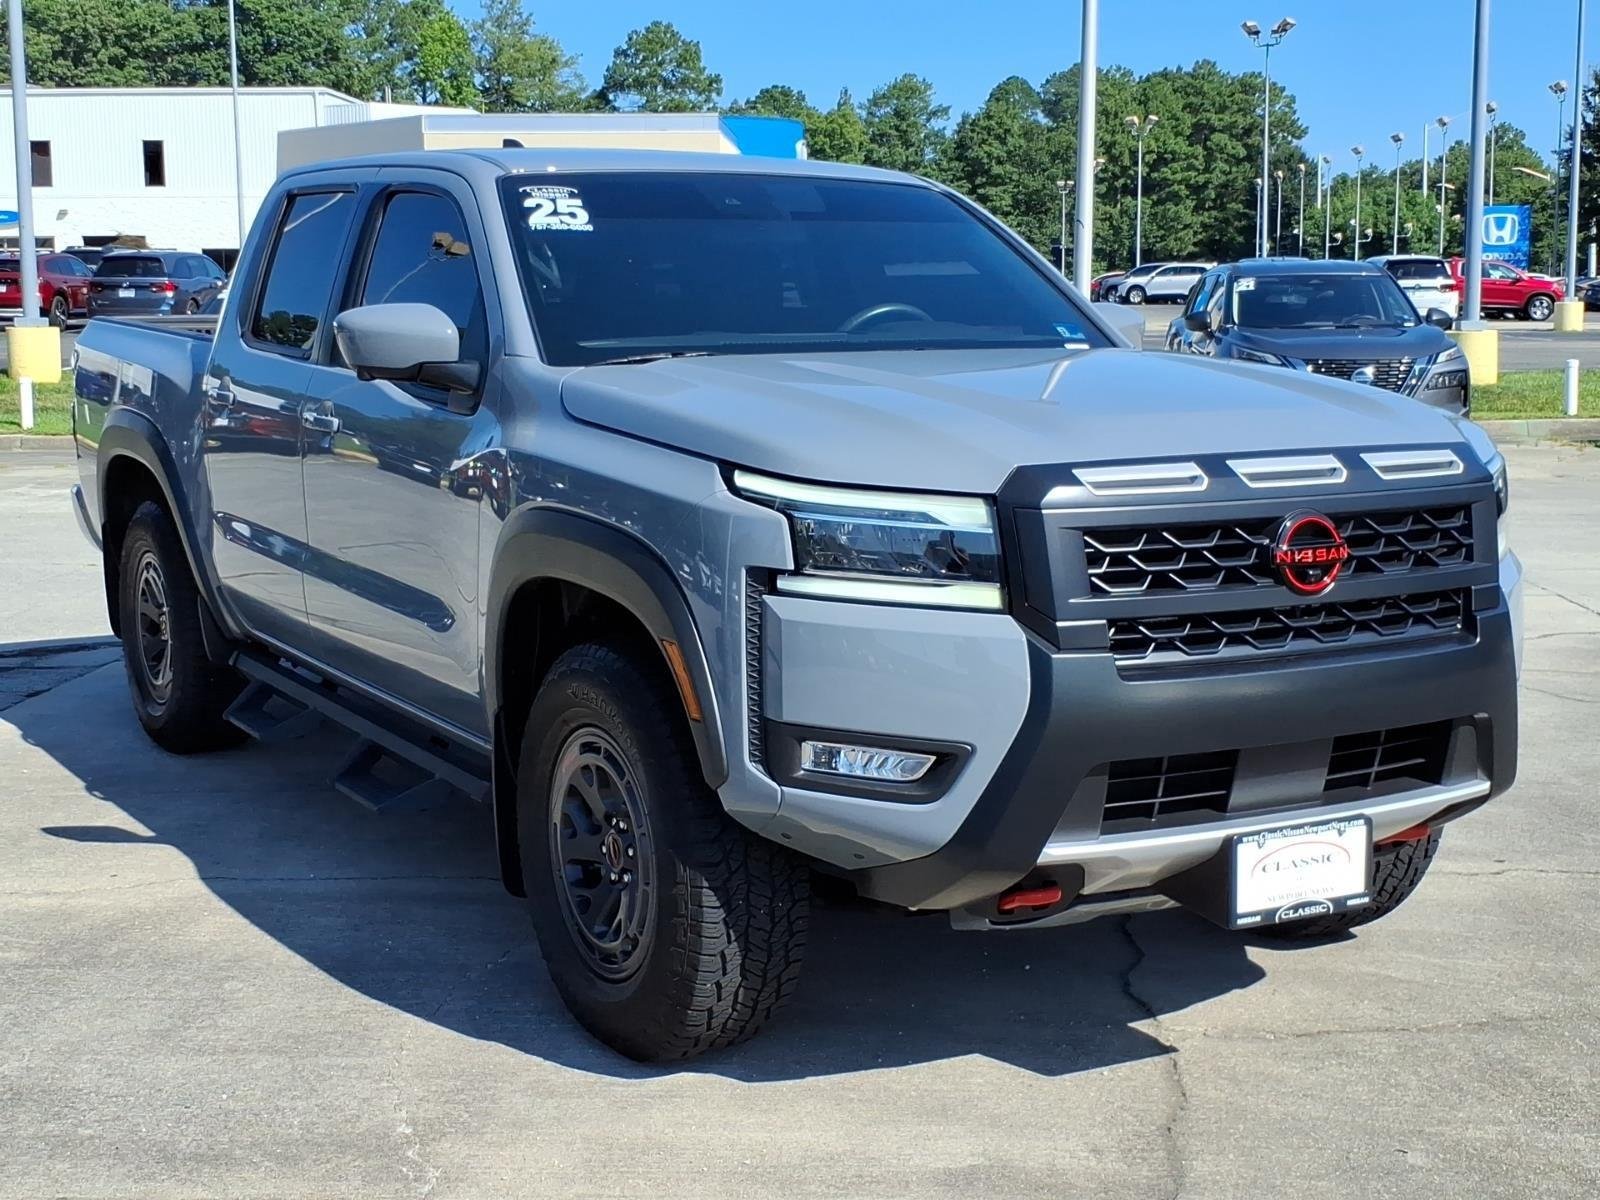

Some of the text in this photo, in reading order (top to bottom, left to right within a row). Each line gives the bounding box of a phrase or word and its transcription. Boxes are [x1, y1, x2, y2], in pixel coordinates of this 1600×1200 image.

[523, 198, 589, 225] 25
[1481, 252, 1527, 260] ONDA
[1276, 547, 1348, 563] NISSAN
[1261, 853, 1333, 873] CLASSIC
[1280, 903, 1328, 919] CLASSIC
